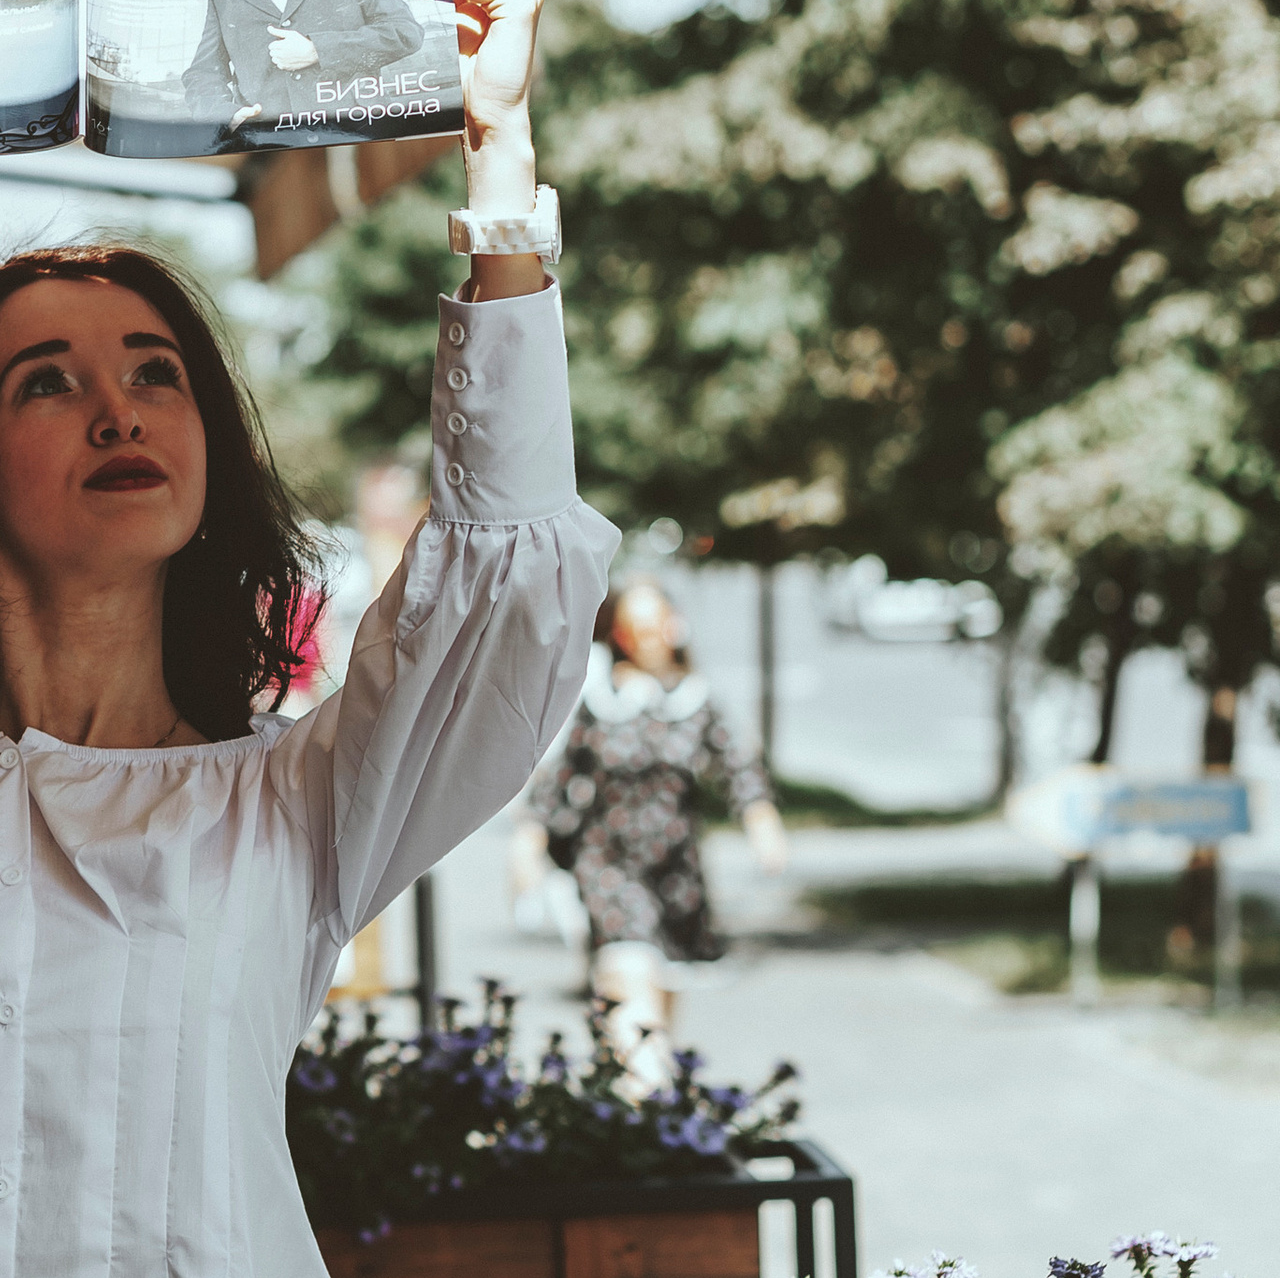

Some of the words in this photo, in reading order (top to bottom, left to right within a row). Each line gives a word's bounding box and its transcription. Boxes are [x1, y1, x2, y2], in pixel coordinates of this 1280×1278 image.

[315, 70, 441, 104] БИЗНЕС
[91, 118, 113, 133] 16+
[274, 110, 327, 132] для
[335, 97, 441, 126] города
